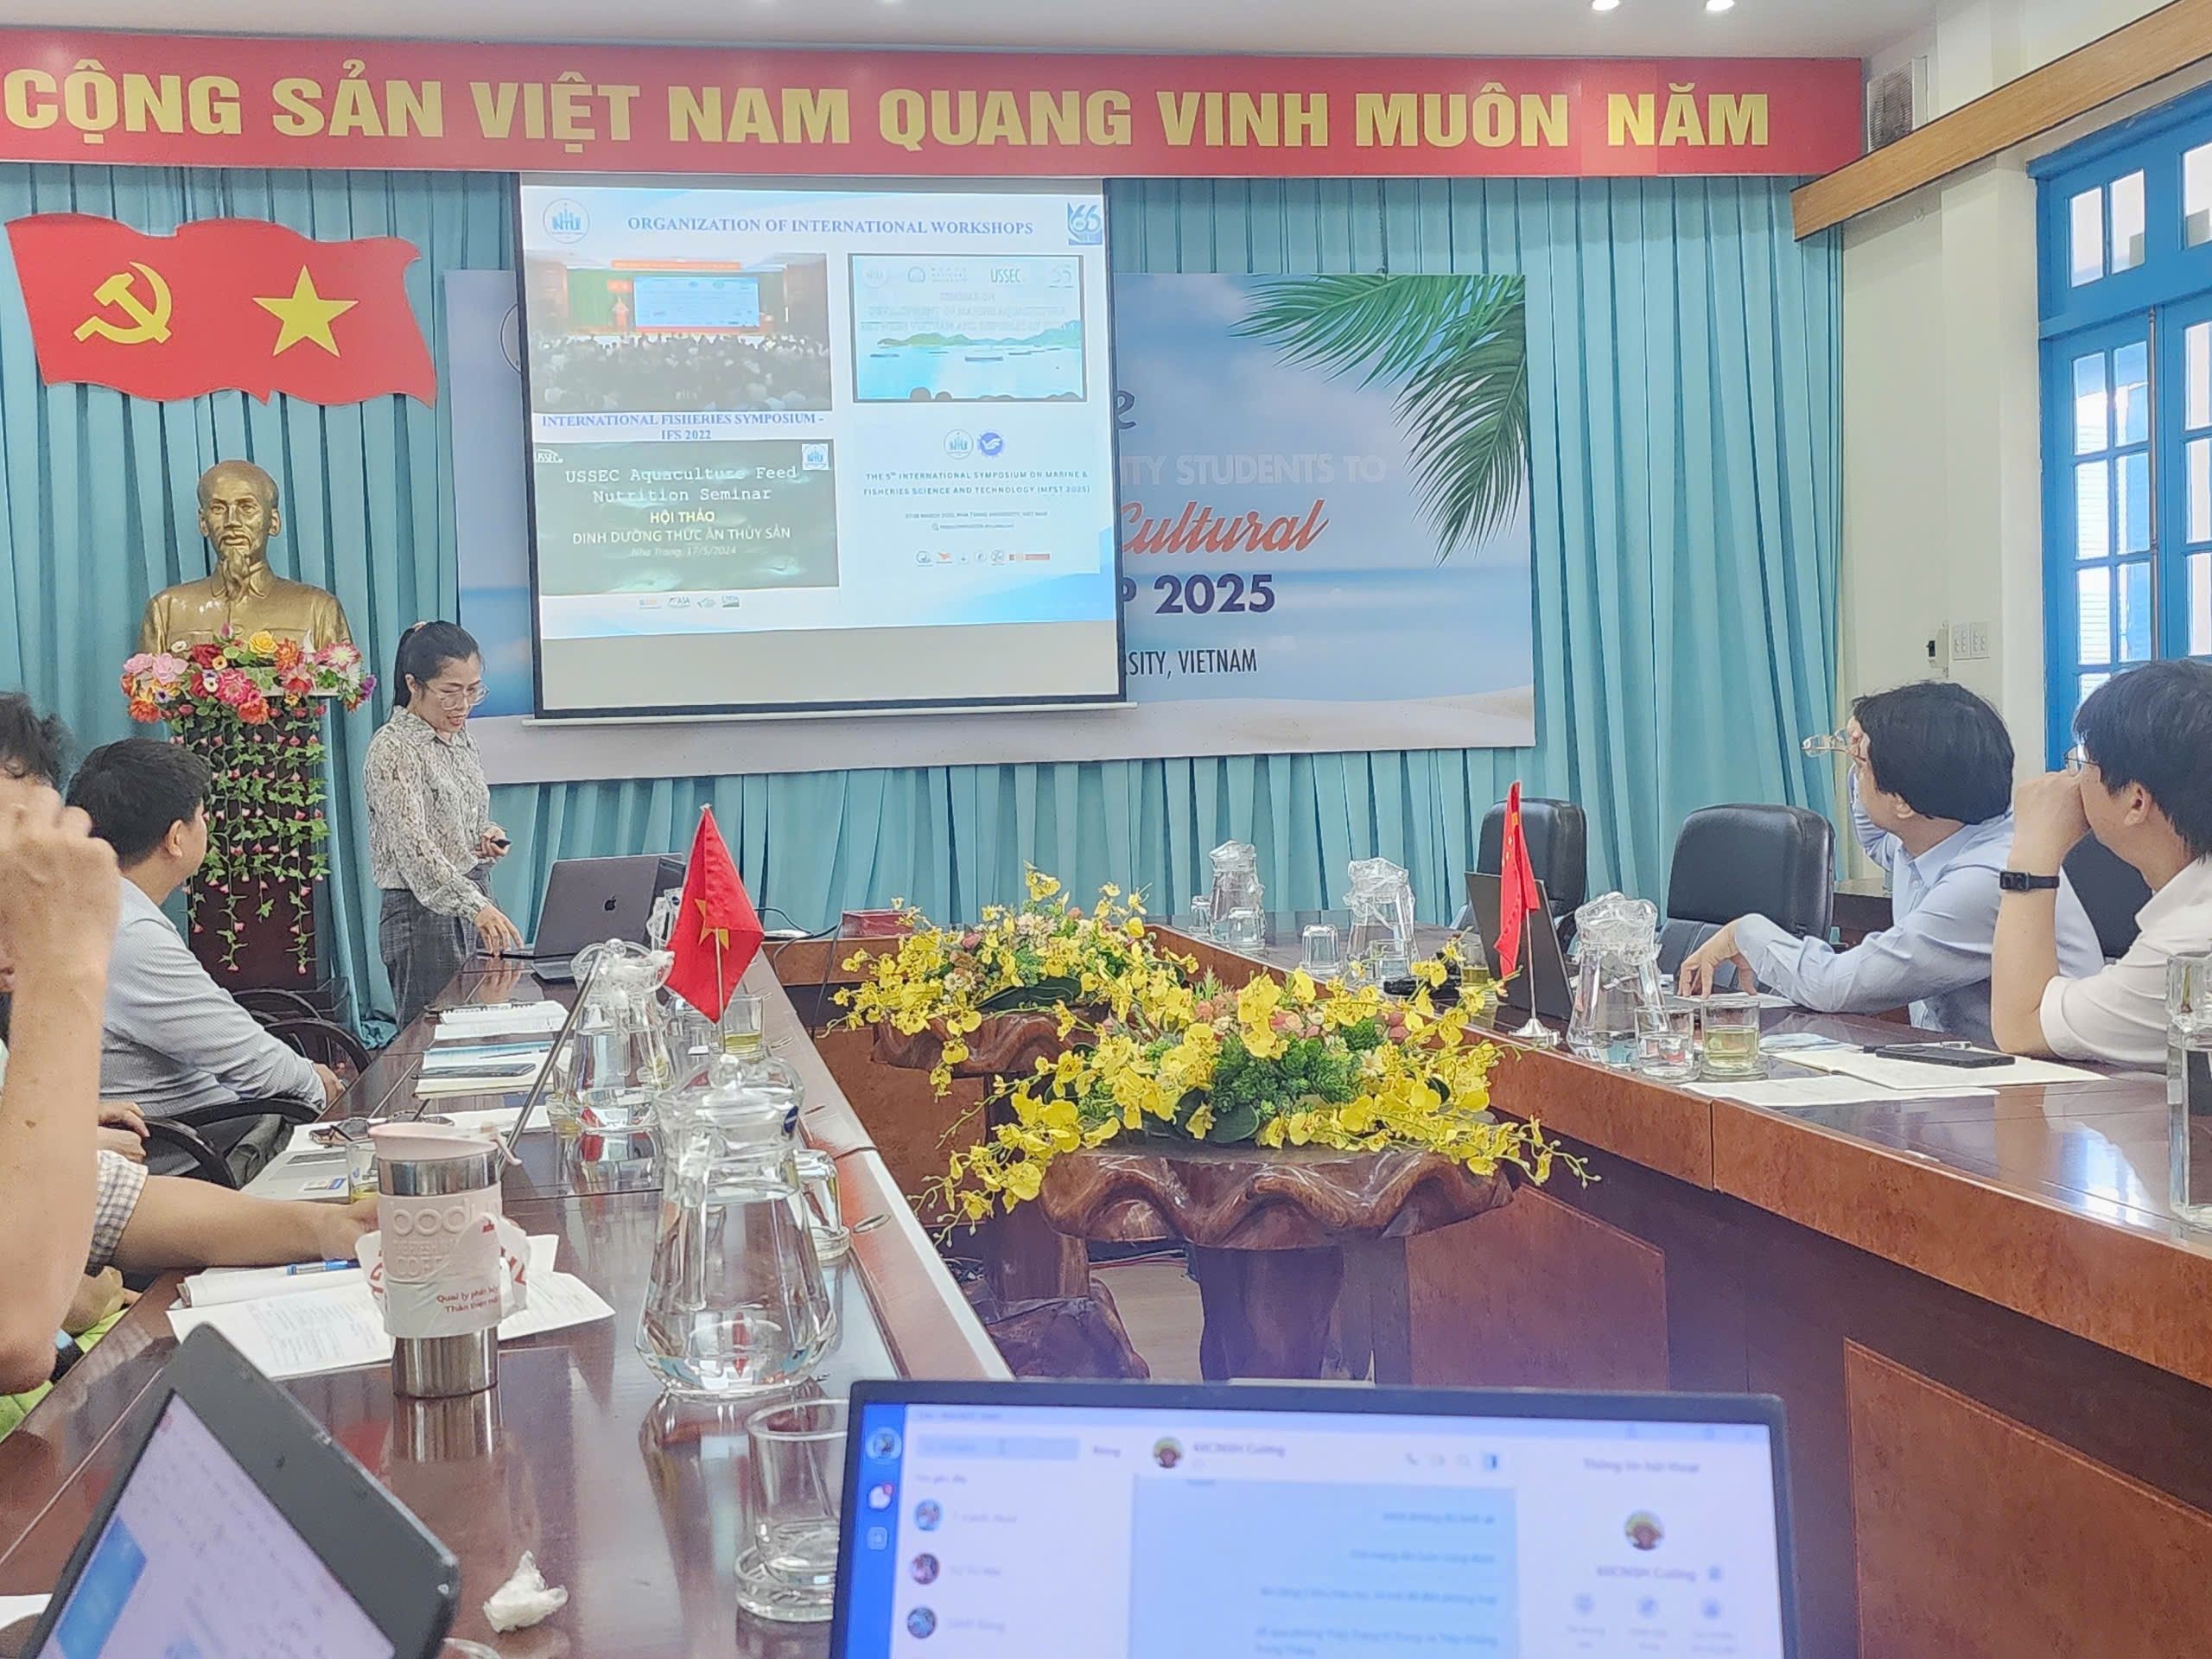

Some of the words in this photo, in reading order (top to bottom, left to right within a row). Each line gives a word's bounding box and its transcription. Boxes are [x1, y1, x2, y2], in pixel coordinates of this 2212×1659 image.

[3, 59, 239, 144] CỘNG
[272, 60, 443, 139] SẢN
[469, 72, 640, 153] VIỆT
[669, 86, 850, 144] NAM
[879, 89, 1131, 151] QUANG
[1156, 92, 1328, 148] VINH
[1356, 82, 1567, 148] MUÔN
[1607, 82, 1768, 148] NĂM
[628, 216, 760, 232] ORGANIZATION
[766, 219, 787, 232] OF
[792, 219, 927, 234] INTERNATIONAL
[931, 220, 1033, 234] WORKSHOPS
[990, 269, 1021, 283] USSEC
[543, 415, 658, 427] INTERNATIONAL
[661, 414, 732, 425] FISHERIES
[734, 413, 816, 424] SYMPOSIUM
[662, 429, 682, 440] IFS
[685, 429, 711, 440] 2022
[565, 469, 620, 483] USSEC
[629, 467, 747, 484] Aquaculture
[756, 466, 797, 480] Feed
[899, 472, 970, 480] INTERNATIONAL
[1176, 453, 1333, 486] STUDENTS
[1342, 454, 1387, 484] TO
[593, 487, 689, 503] Nutrition
[700, 487, 772, 501] Seminar
[863, 487, 909, 496] FISHERIES
[953, 486, 972, 495] AND
[650, 508, 674, 525] HỘI
[677, 507, 715, 523] THẢO
[573, 531, 607, 544] DINH
[1154, 573, 1274, 614] 2025
[1179, 649, 1257, 673] VIETNAM
